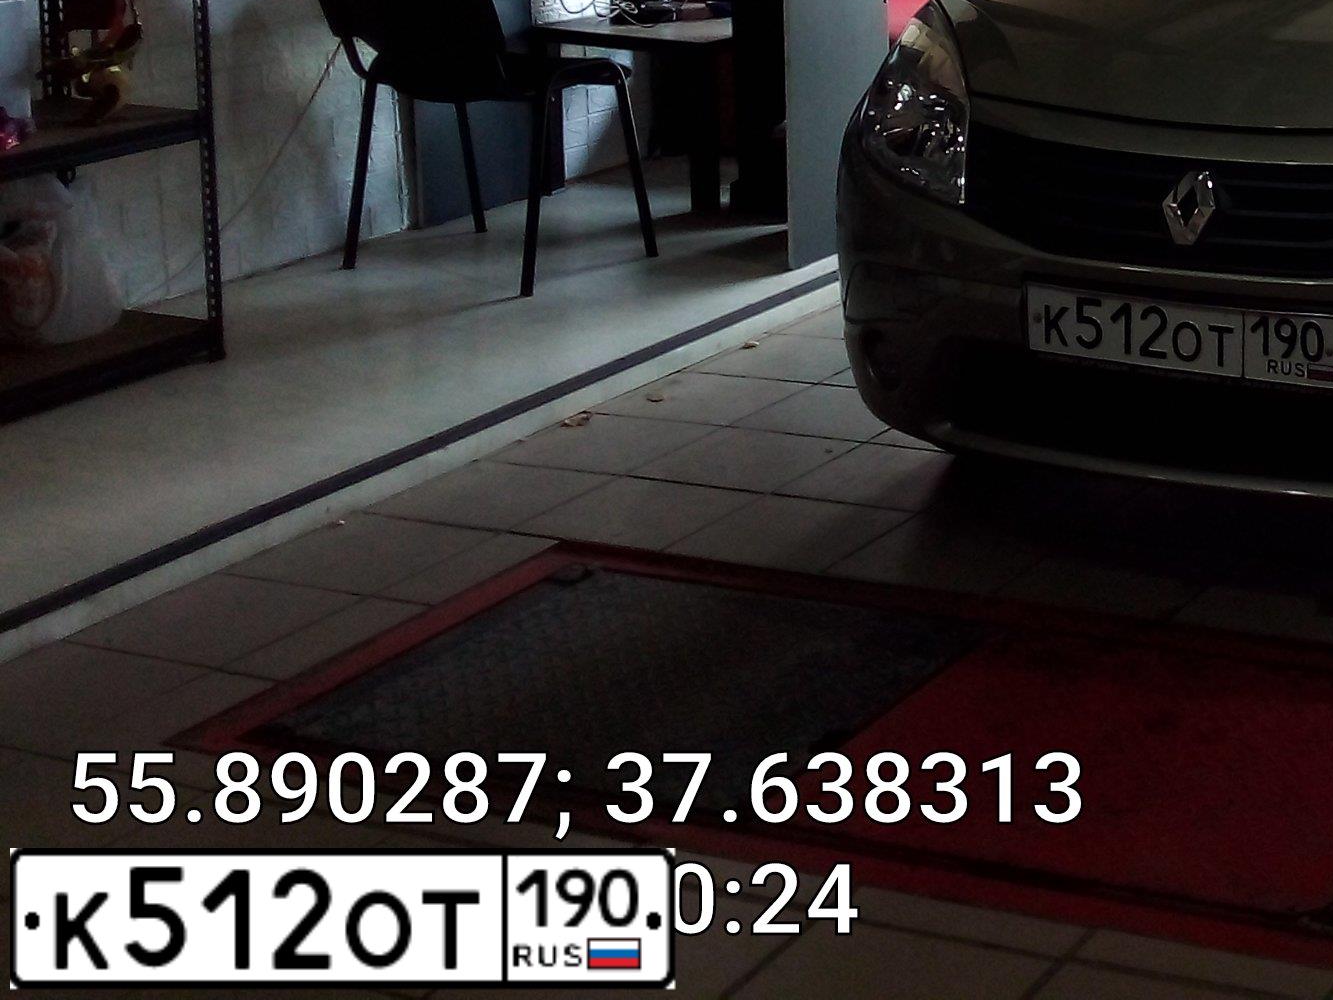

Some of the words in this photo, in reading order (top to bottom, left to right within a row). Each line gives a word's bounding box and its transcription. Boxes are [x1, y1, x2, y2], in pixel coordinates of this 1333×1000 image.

[1043, 296, 1234, 368] К512ОТ
[1250, 315, 1325, 363] 190
[1266, 358, 1306, 378] RUS
